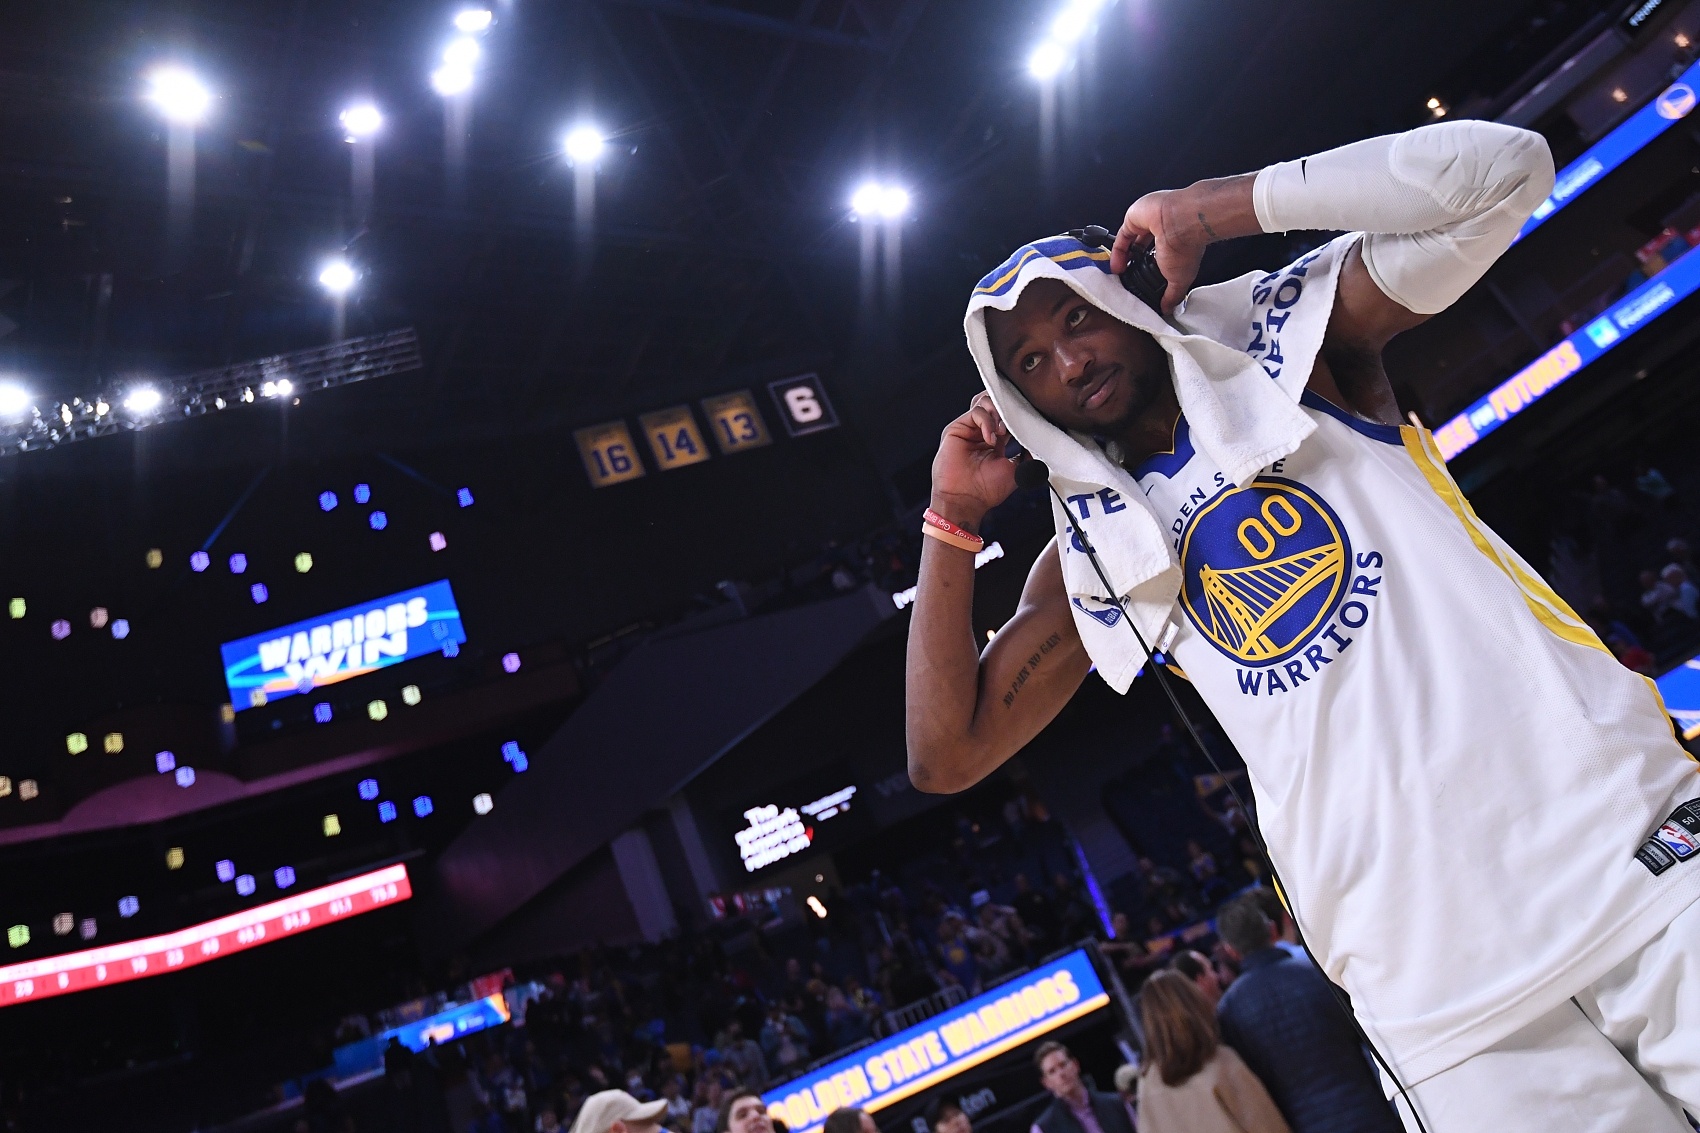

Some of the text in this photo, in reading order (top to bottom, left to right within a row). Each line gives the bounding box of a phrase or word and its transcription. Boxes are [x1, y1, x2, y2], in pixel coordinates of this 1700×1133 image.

[784, 386, 823, 423] 6
[1487, 338, 1582, 422] FUTURES
[657, 427, 698, 462] 14
[718, 412, 760, 446] 13
[591, 443, 633, 479] 16
[1237, 494, 1302, 560] 00
[258, 596, 429, 672] WARRIORS
[1235, 550, 1384, 697] WARRIORS
[284, 630, 408, 686] WIN
[1003, 631, 1061, 709] NO PAIN NO GAIN
[1681, 816, 1695, 826] 50
[864, 1031, 949, 1093] STATE
[938, 969, 1081, 1058] WARRIORS
